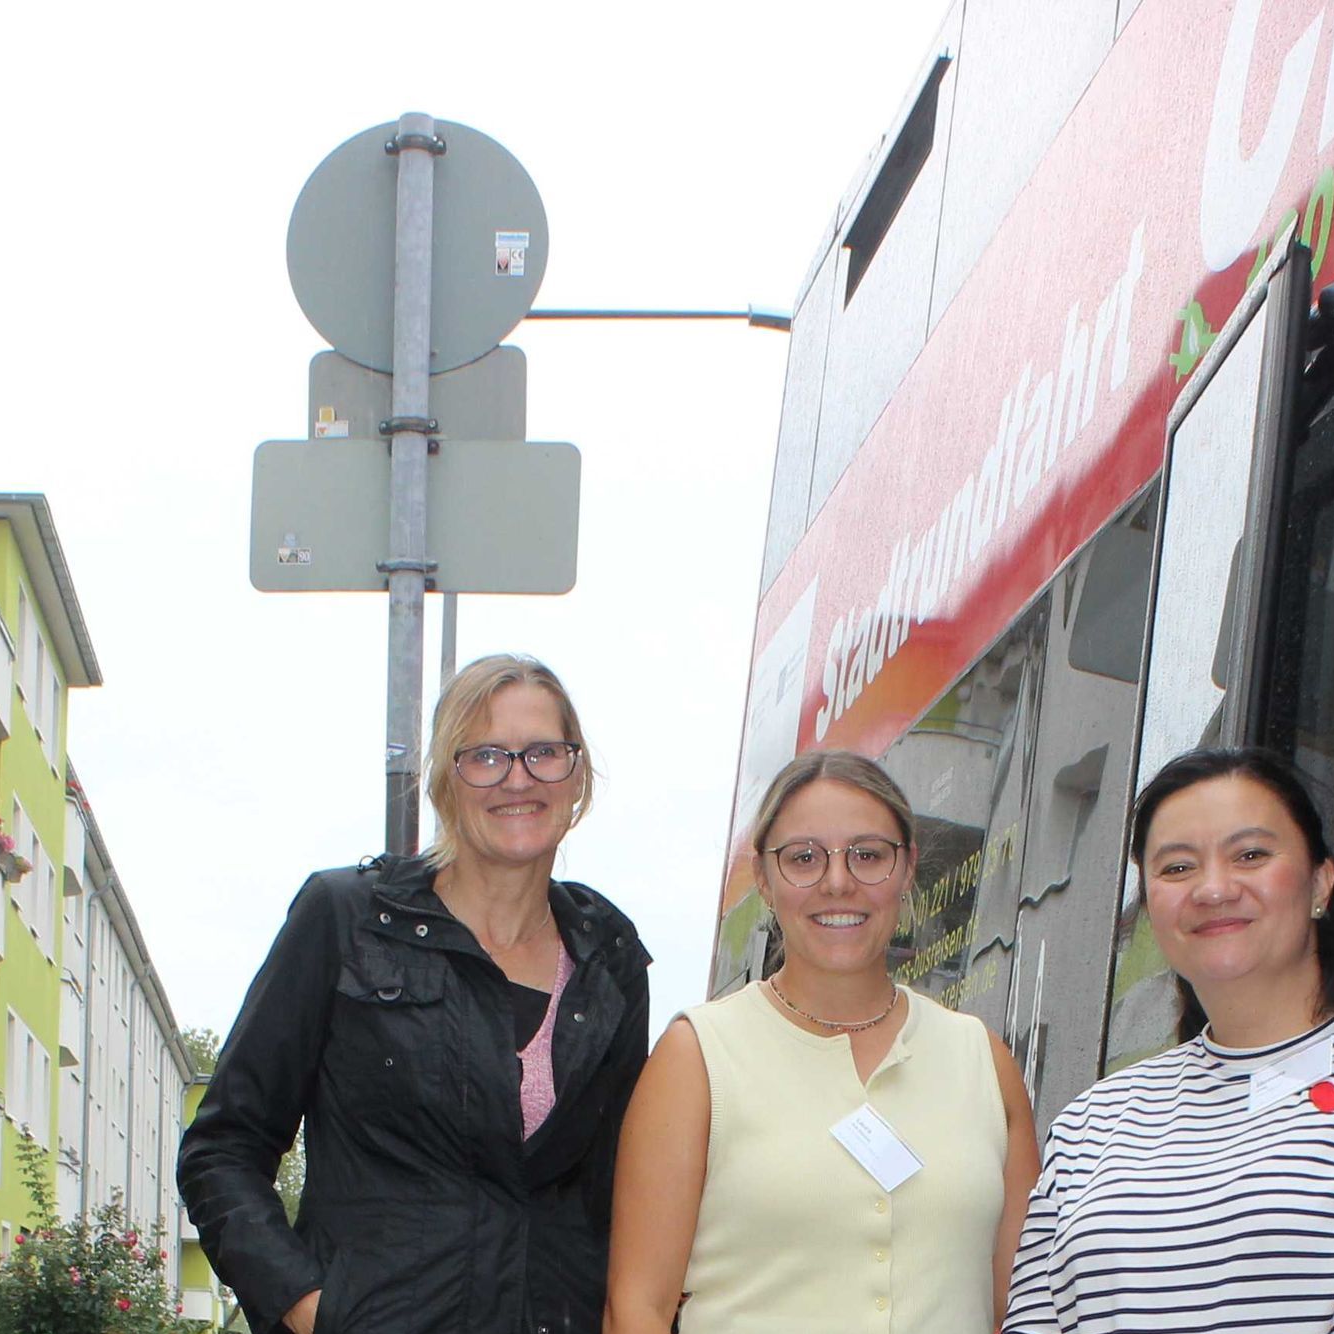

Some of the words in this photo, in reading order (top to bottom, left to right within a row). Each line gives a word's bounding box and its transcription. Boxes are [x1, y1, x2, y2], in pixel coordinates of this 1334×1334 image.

[815, 214, 1147, 744] Stadtrundfahrt
[929, 873, 951, 918] 221
[959, 849, 981, 897] 979
